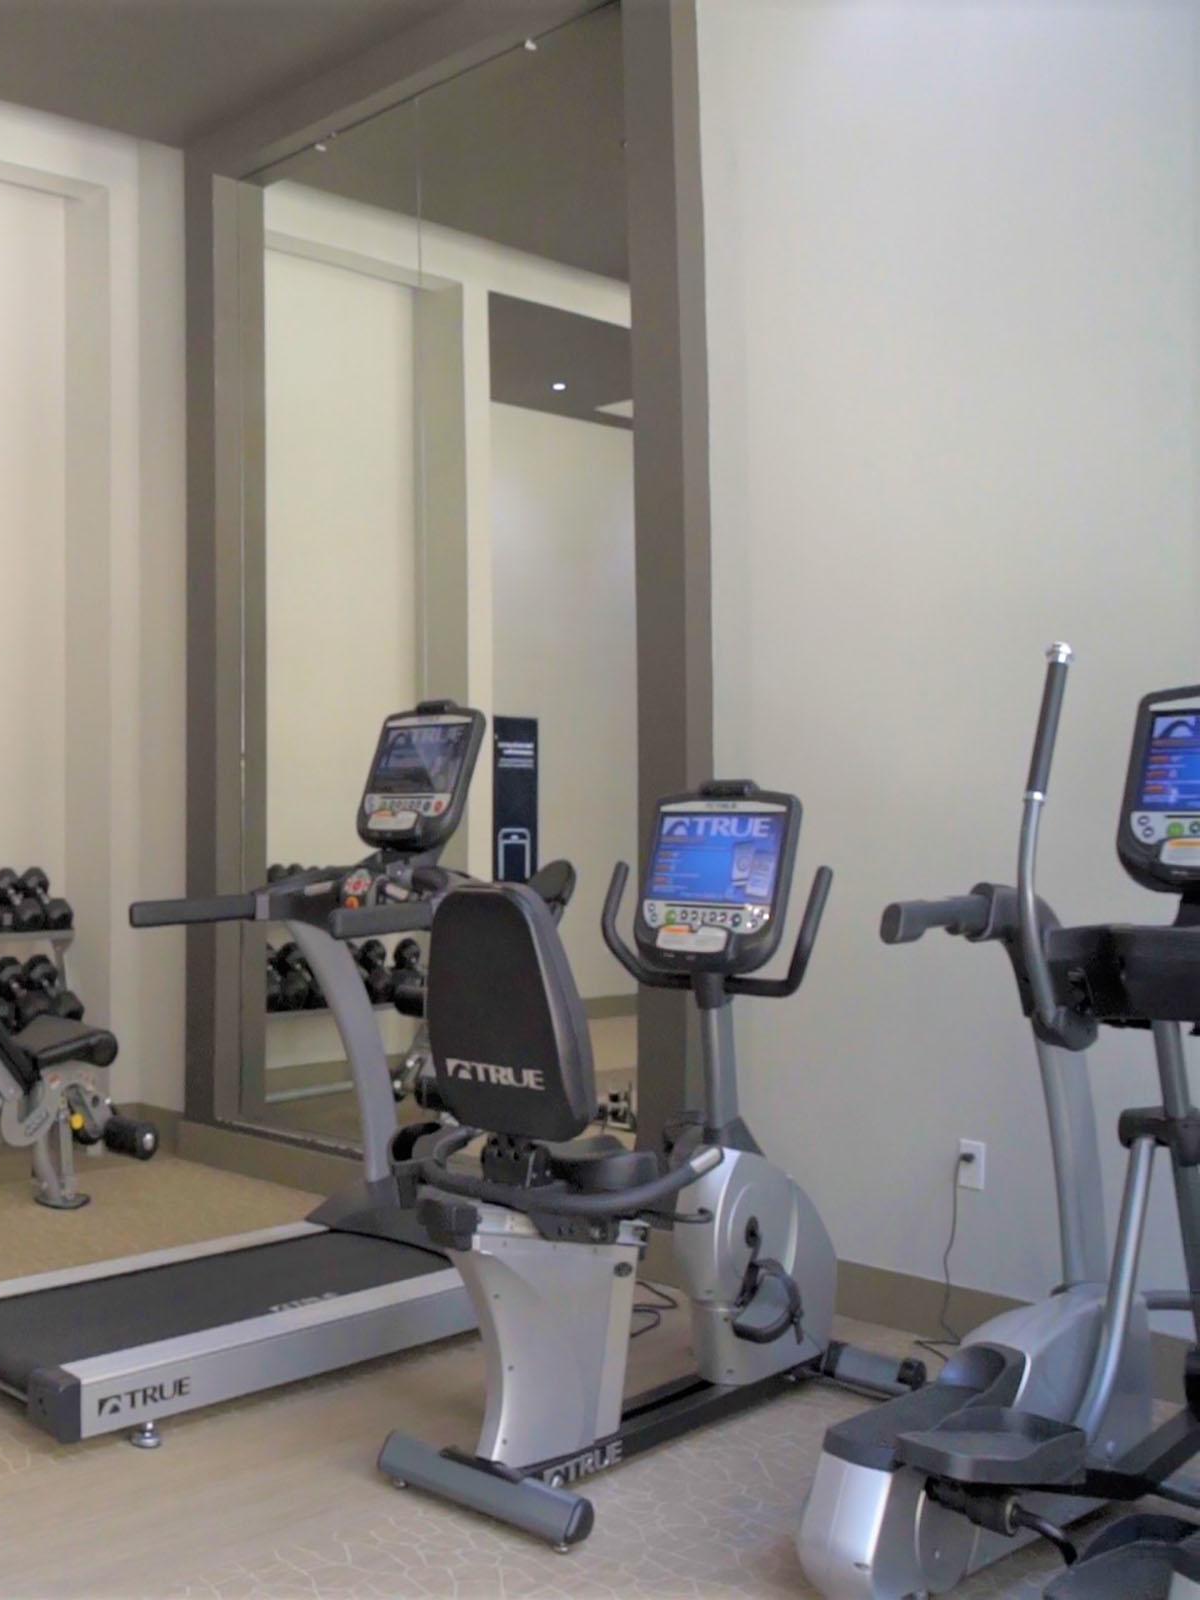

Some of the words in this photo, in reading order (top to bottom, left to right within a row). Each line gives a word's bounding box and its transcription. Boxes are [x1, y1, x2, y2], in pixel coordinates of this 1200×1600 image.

[691, 816, 772, 838] TRUE
[471, 1060, 546, 1092] TRUE
[123, 1376, 191, 1409] TRUE
[563, 1439, 623, 1482] TRUE
